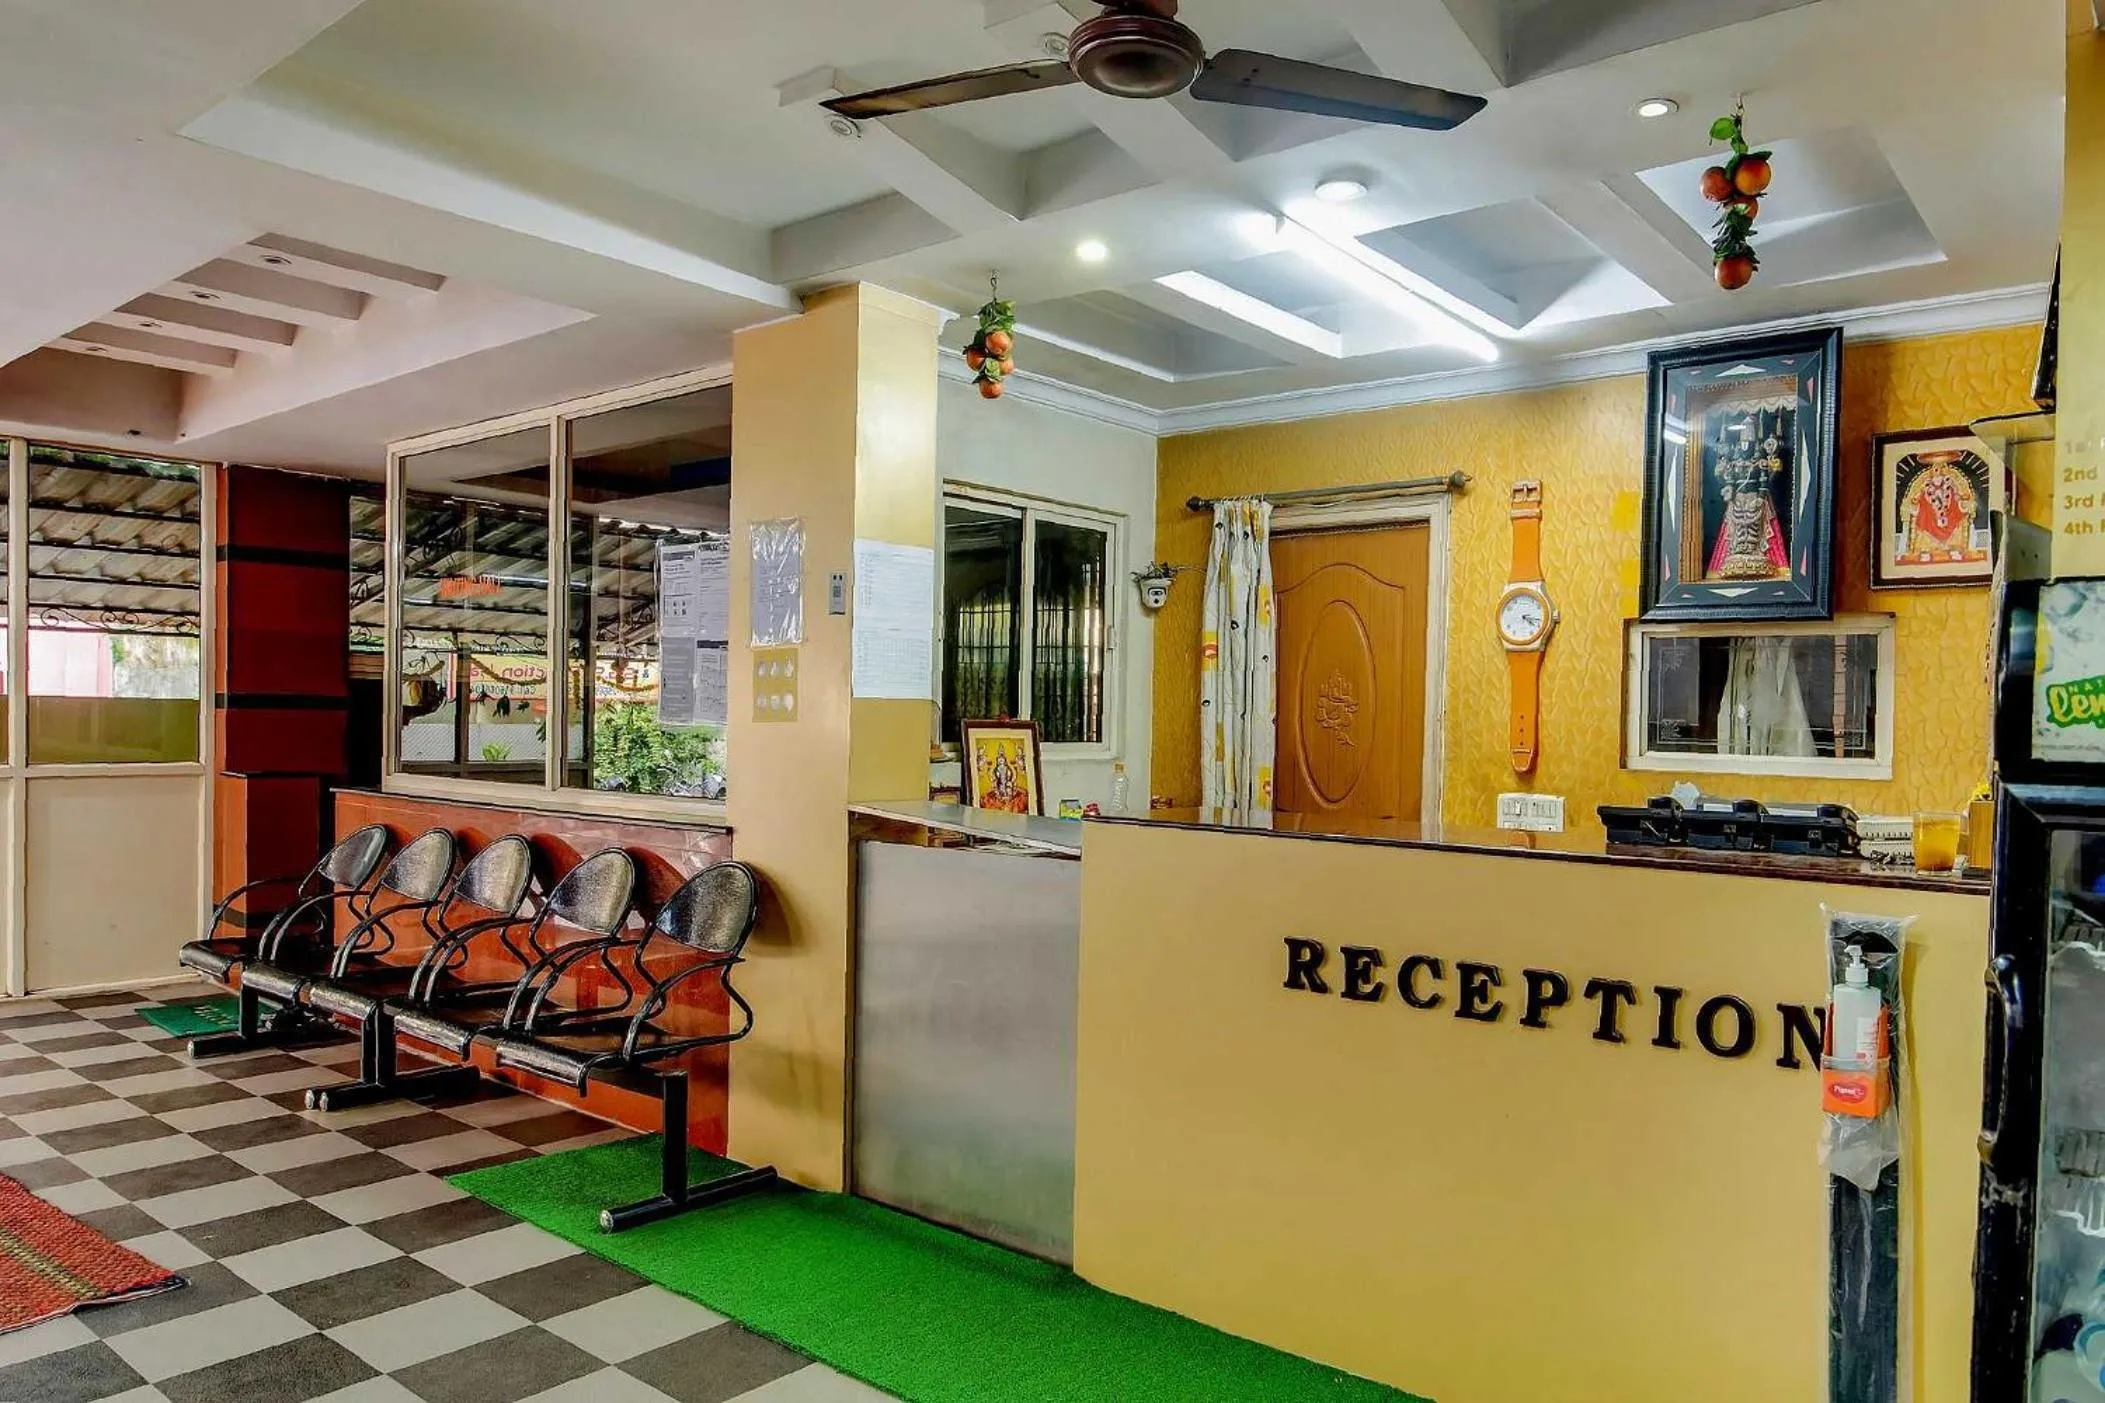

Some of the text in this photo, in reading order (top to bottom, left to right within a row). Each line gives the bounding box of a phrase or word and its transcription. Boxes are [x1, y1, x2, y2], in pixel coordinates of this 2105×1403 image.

[2063, 466, 2098, 482] 2nd
[2064, 494, 2094, 510] 3rd
[2064, 521, 2093, 536] 4th
[1282, 935, 1826, 1072] RECEPTION
